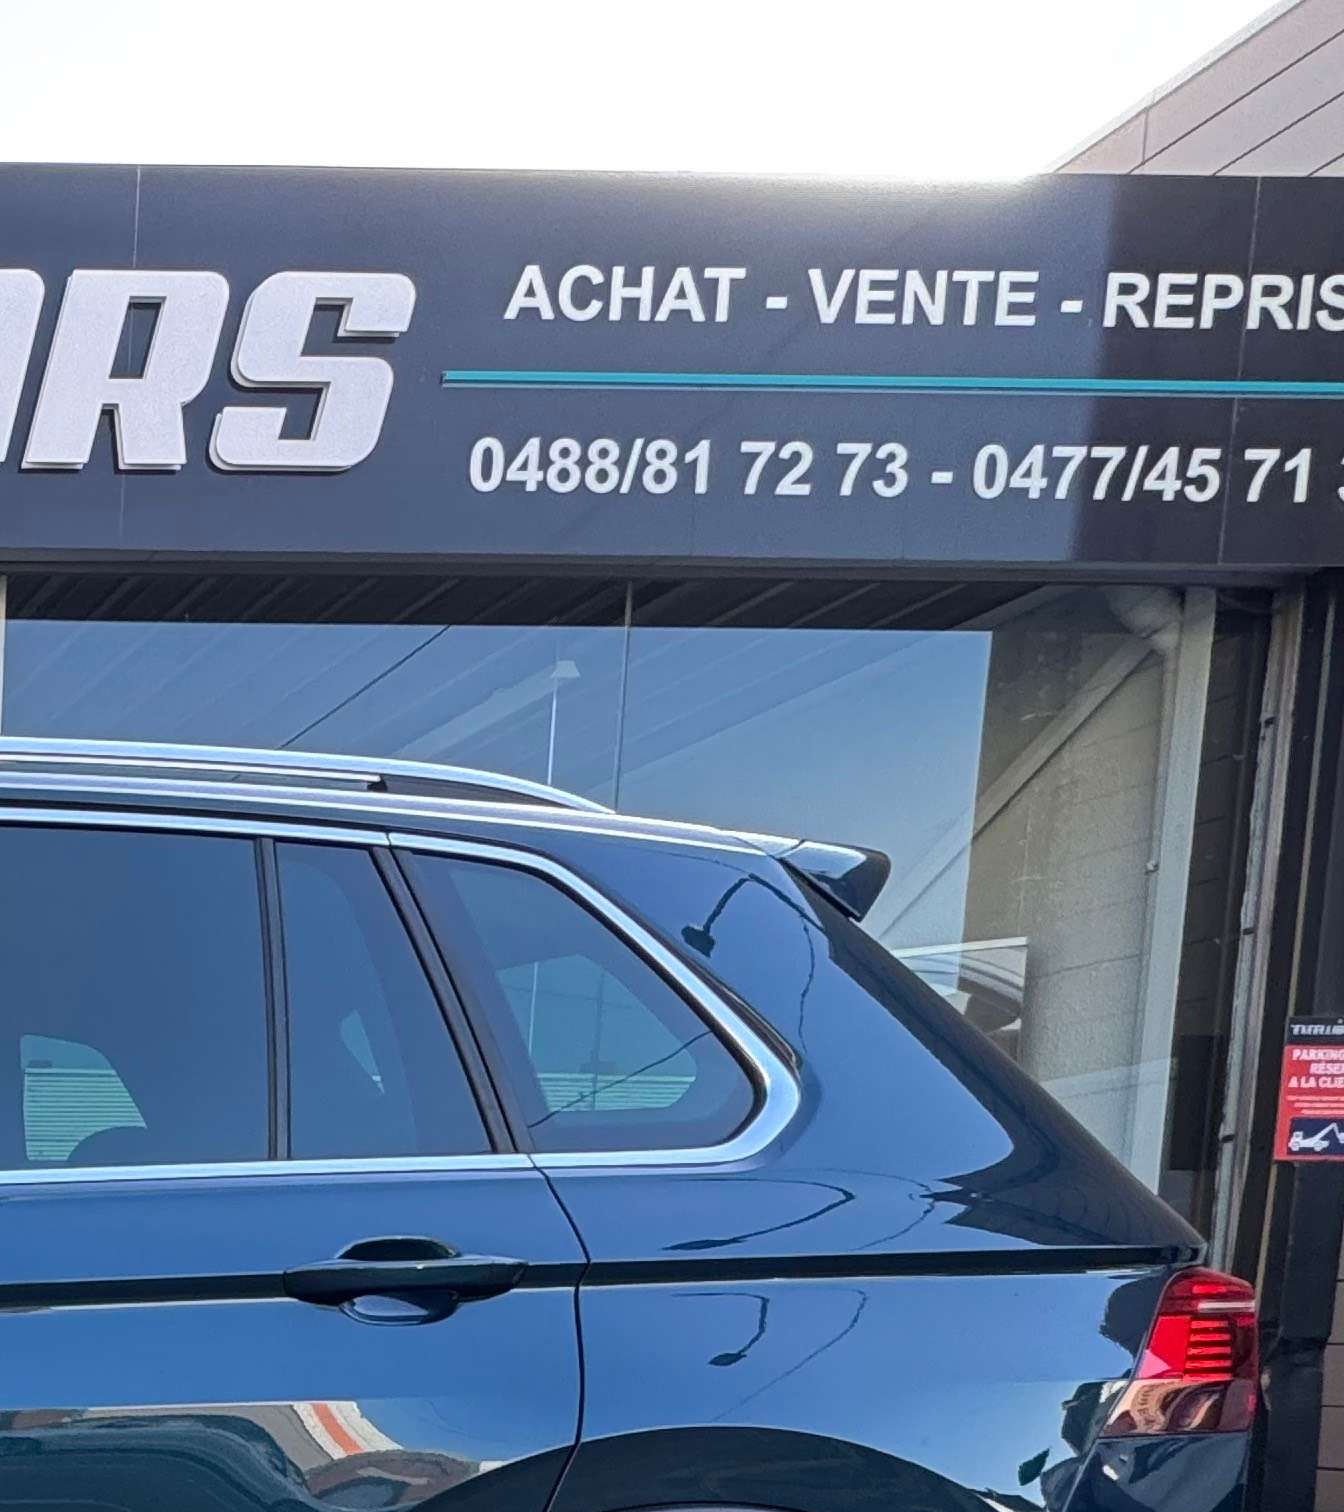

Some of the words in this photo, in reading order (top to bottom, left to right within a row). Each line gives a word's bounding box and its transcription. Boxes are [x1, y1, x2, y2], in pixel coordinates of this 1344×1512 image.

[503, 263, 747, 322] ACHAT
[765, 294, 789, 311] -
[807, 267, 1041, 327] VENTE
[1059, 297, 1084, 314] -
[1101, 270, 1344, 333] REPRIS
[468, 435, 712, 496] 0488/81
[739, 440, 814, 497] 72
[836, 441, 910, 499] 73
[930, 471, 954, 486] -
[972, 444, 1222, 503] 0477/45
[1243, 447, 1312, 504] 71
